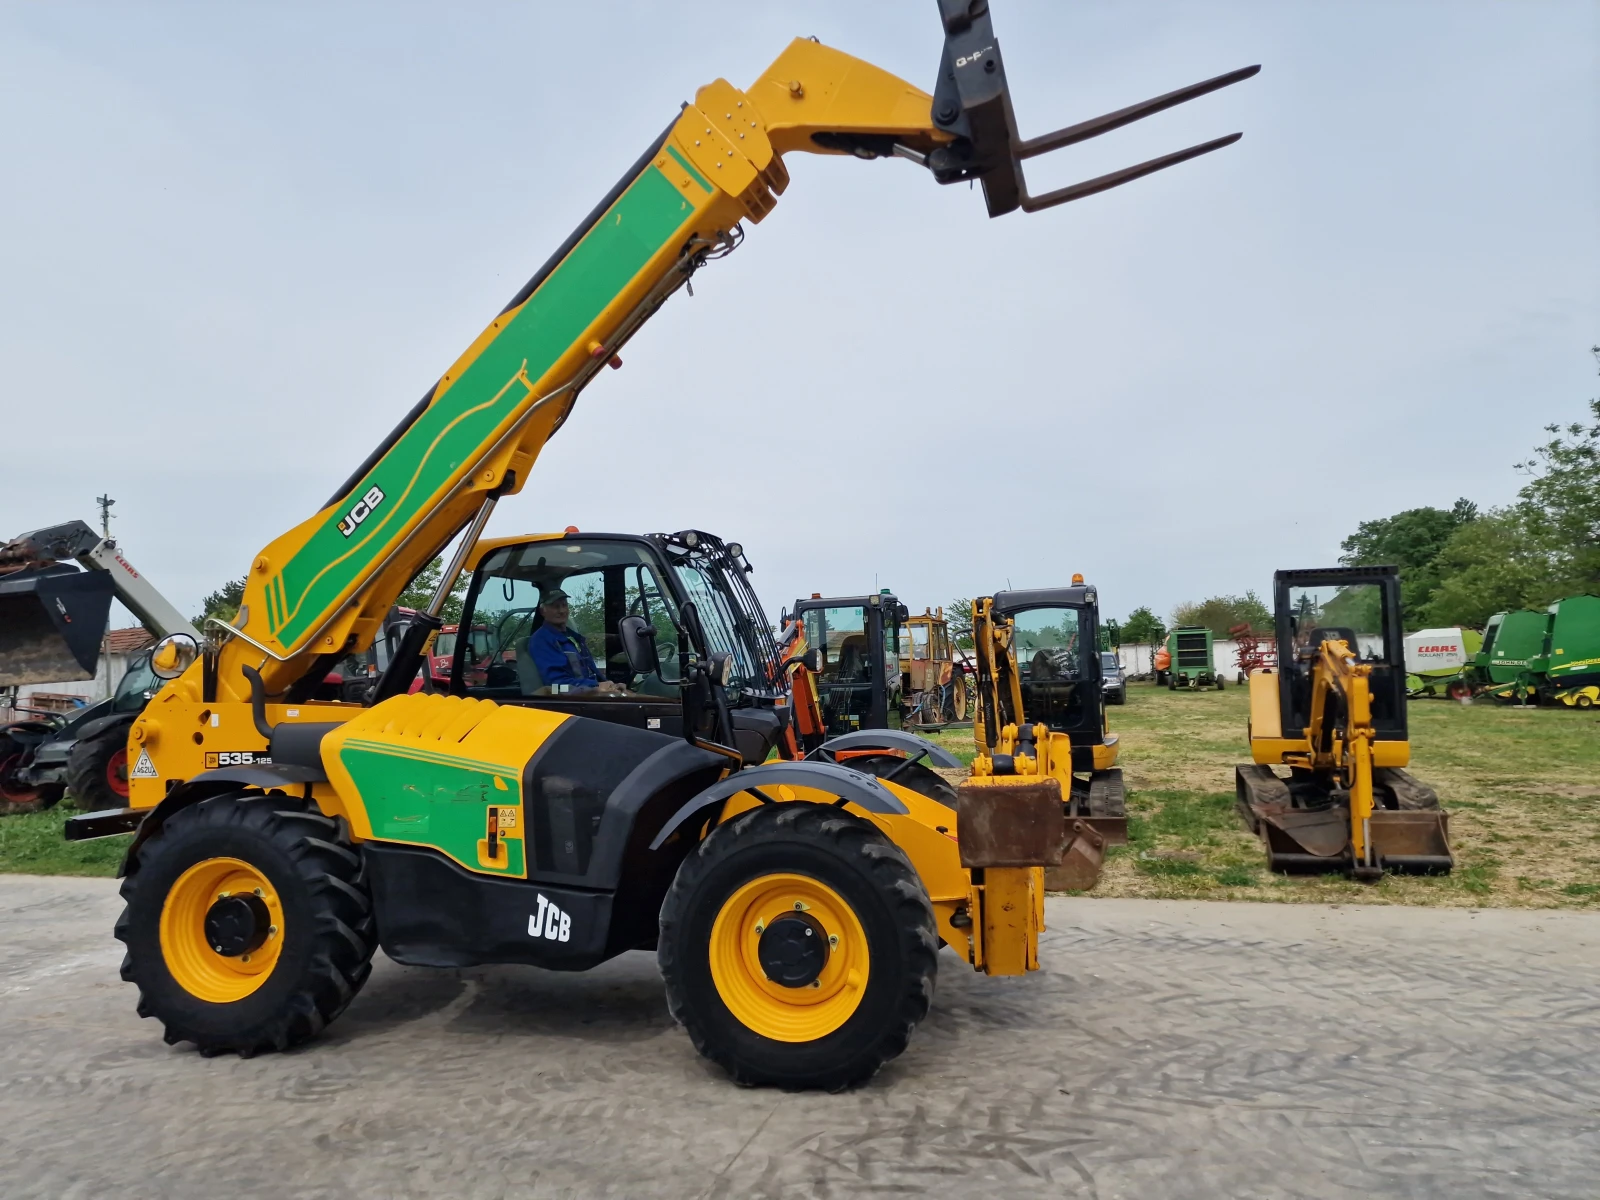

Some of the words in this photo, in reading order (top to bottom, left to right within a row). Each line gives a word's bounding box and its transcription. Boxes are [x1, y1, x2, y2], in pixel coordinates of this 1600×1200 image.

[342, 486, 384, 536] JCB
[115, 555, 139, 579] CLAAS
[1417, 645, 1458, 653] CLAAS
[527, 893, 571, 942] JCB
